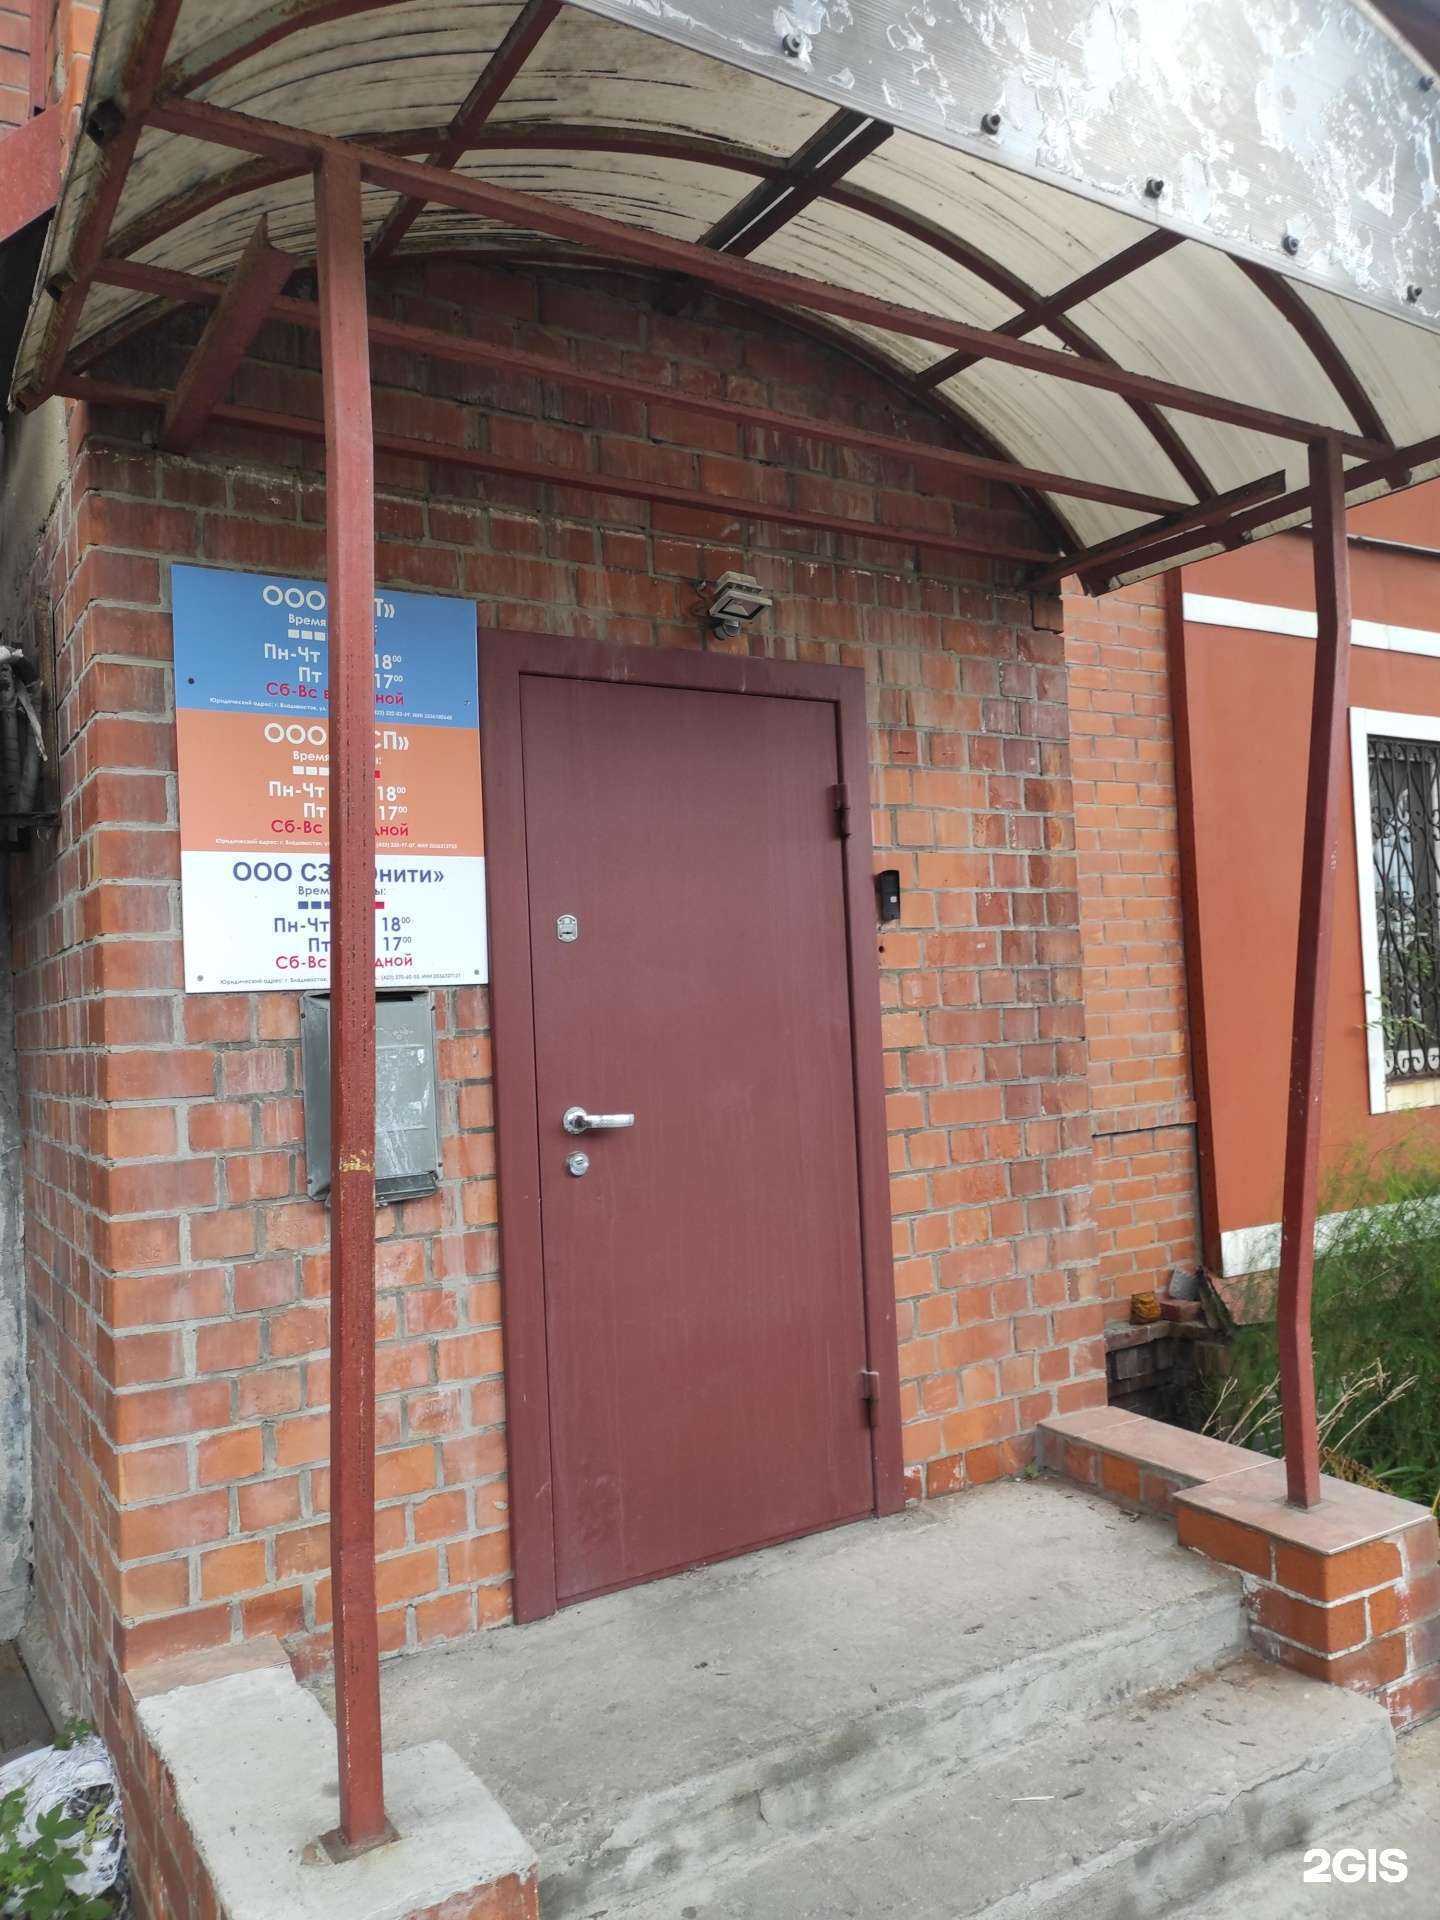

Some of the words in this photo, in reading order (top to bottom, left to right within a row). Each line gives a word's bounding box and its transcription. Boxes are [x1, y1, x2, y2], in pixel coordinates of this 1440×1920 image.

[262, 585, 326, 611] ООО
[288, 613, 327, 627] Время
[264, 642, 321, 663] Пн-Чт
[298, 666, 322, 683] Пт
[266, 681, 318, 699] Сб-Вс
[264, 722, 327, 746] ООО
[293, 750, 330, 763] Время
[269, 780, 325, 799] Пн-Чт
[303, 802, 327, 819] Пт
[271, 819, 323, 835] Сб-Вс
[233, 861, 292, 882] ООО
[298, 885, 330, 898] Врем
[274, 917, 330, 933] Пн-Чт
[308, 937, 330, 953] Пт
[275, 955, 327, 970] Сб-Вс
